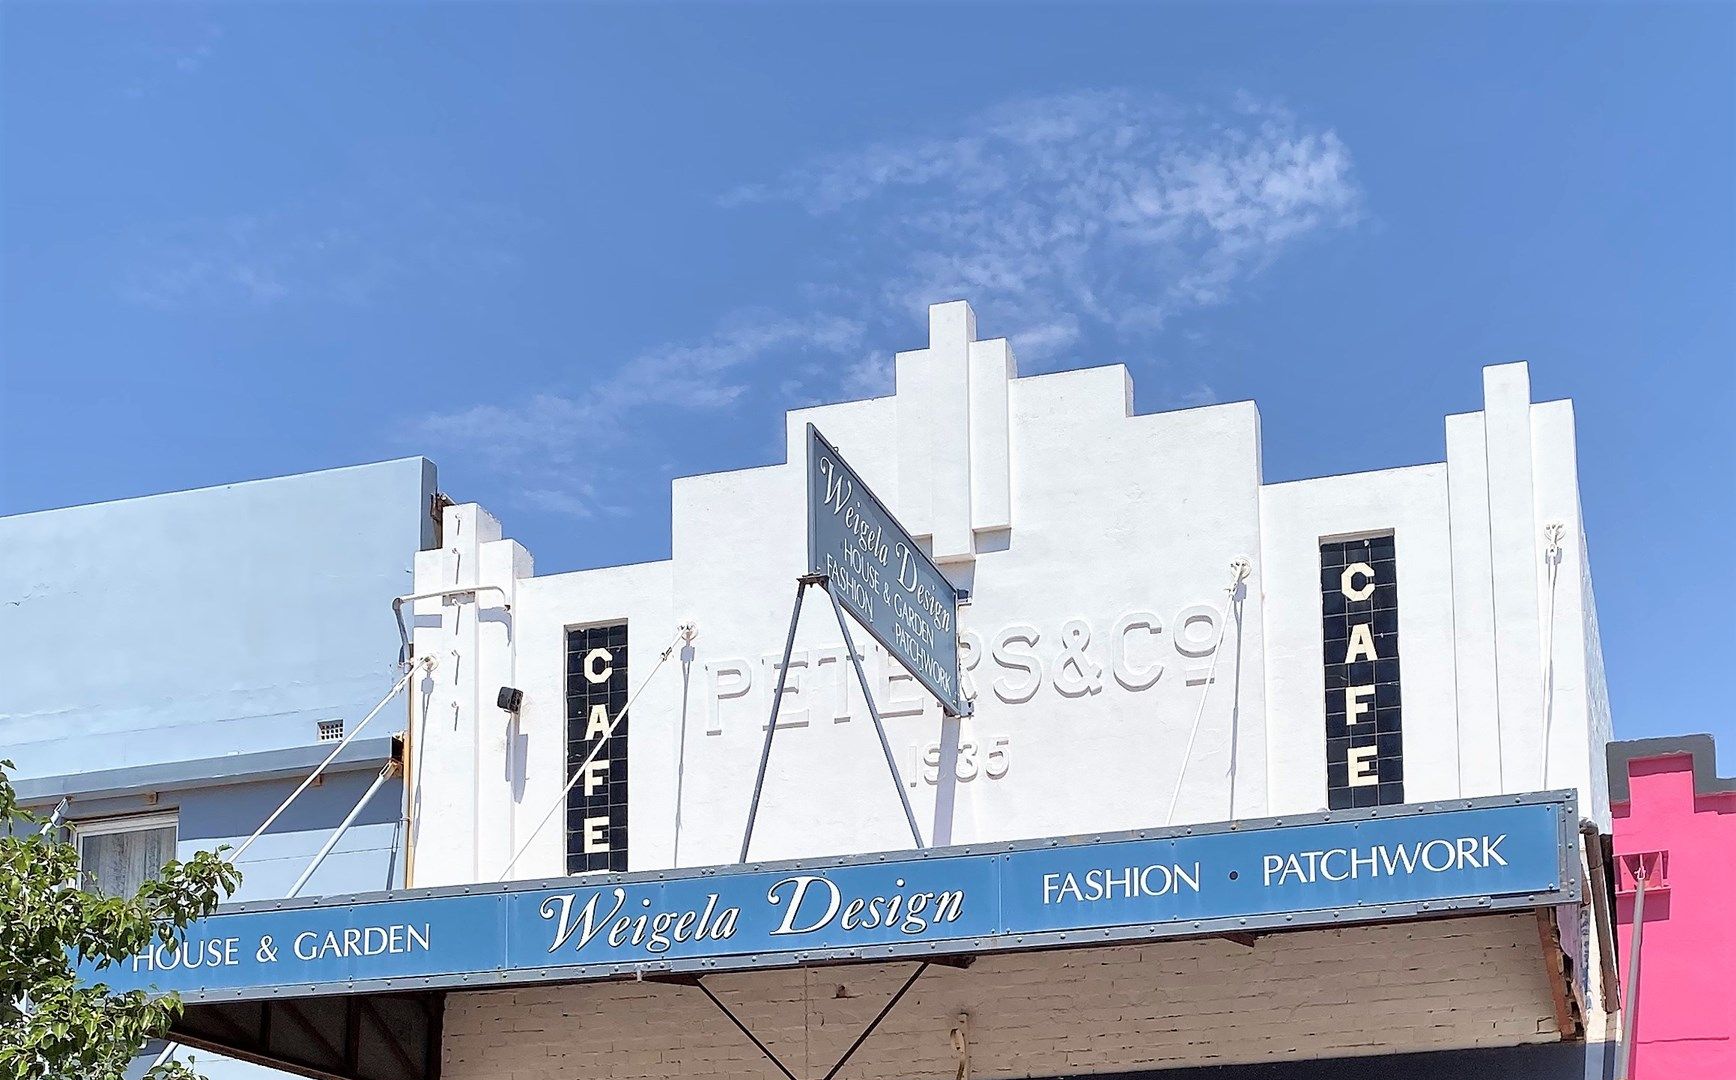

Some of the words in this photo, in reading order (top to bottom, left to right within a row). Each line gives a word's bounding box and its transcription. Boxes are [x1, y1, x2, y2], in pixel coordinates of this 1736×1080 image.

[820, 457, 889, 567] Weigela
[895, 541, 951, 632] Design
[844, 538, 880, 595] HOUSE
[884, 582, 891, 606] &
[893, 593, 935, 650] GARDEN
[826, 552, 874, 622] FASHION
[895, 622, 952, 696] PATCHWORK
[1341, 562, 1379, 788] CAFE
[584, 648, 613, 855] CAFE
[908, 737, 1012, 787] 1935
[132, 937, 240, 973] HOUSE
[255, 935, 279, 963] &
[293, 923, 430, 962] GARDEN
[539, 887, 741, 954] Weigela
[767, 875, 965, 936] Design
[1042, 861, 1201, 905] FASHION
[1263, 833, 1509, 888] PATCHWORK
